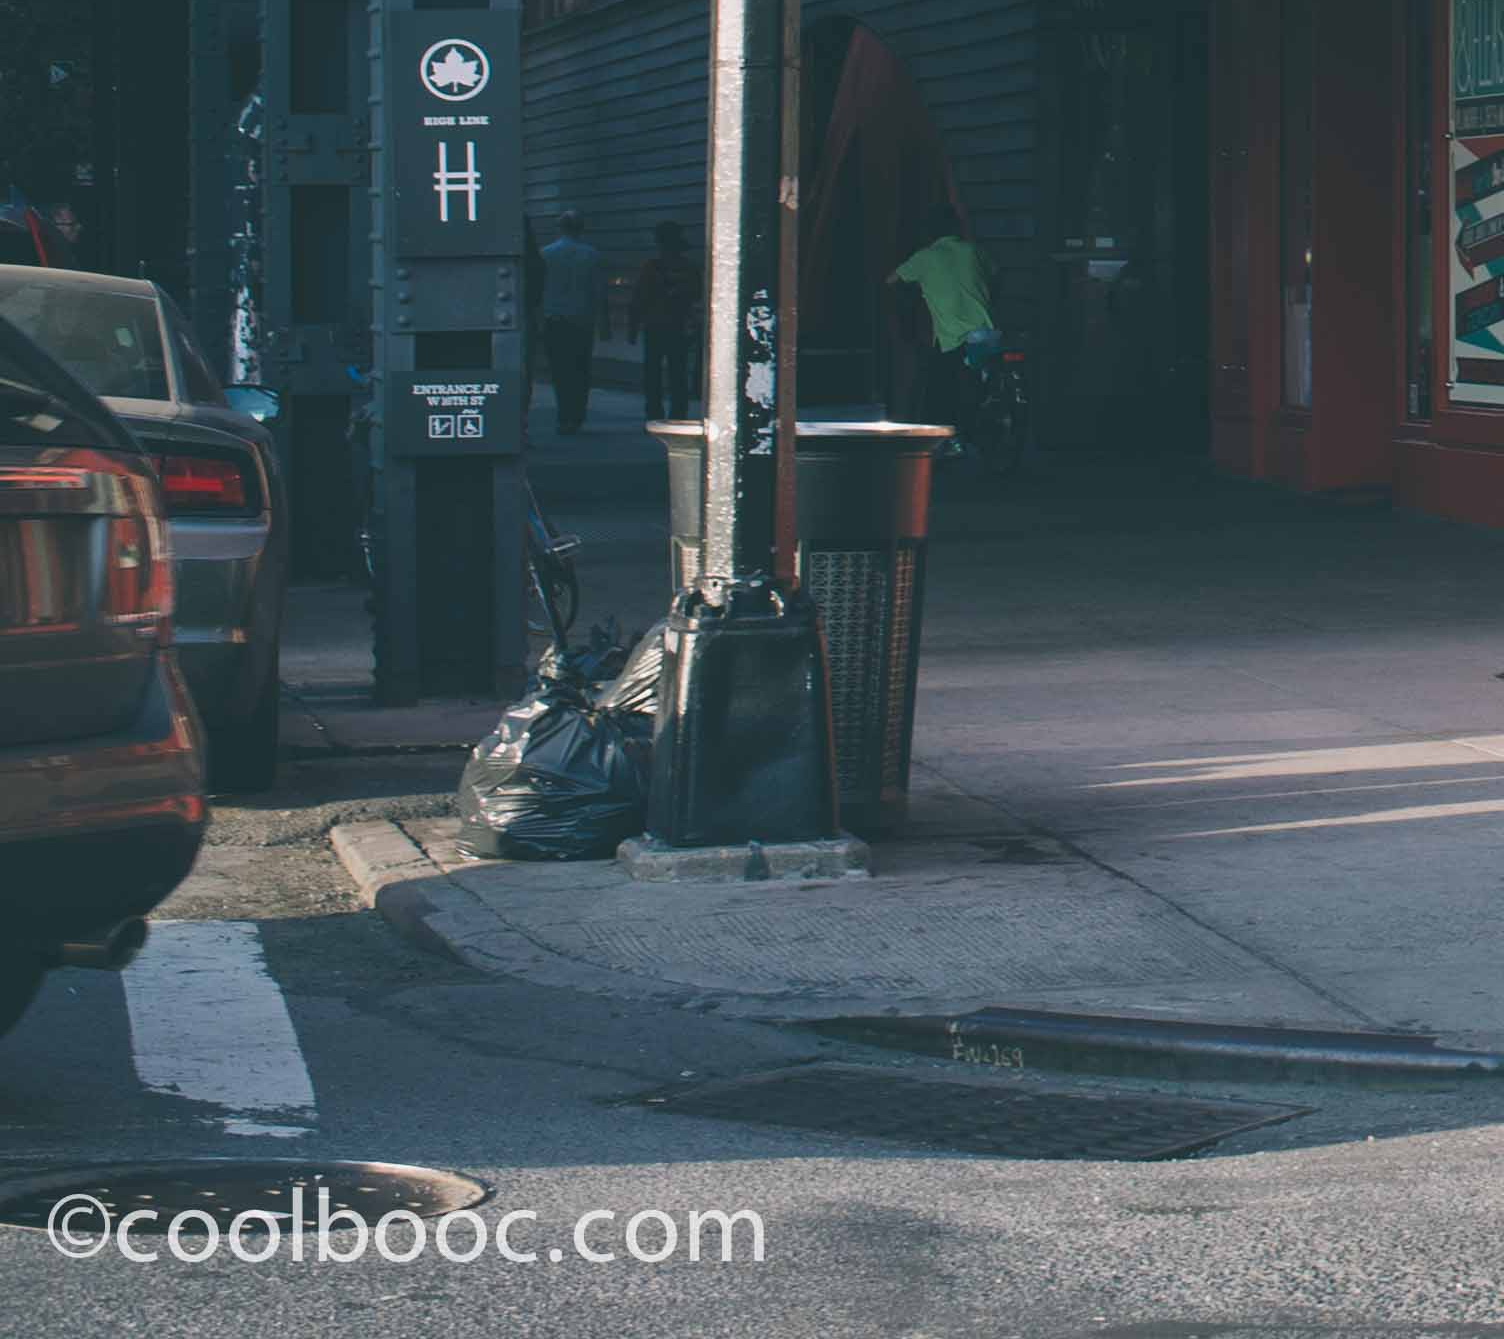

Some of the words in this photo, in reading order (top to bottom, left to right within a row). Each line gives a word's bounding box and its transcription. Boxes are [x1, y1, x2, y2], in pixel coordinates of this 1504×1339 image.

[423, 116, 456, 126] HIGH
[458, 115, 489, 125] LINE
[412, 384, 481, 395] ENTRANCE
[482, 383, 499, 394] AT
[426, 396, 441, 406] W
[469, 396, 486, 406] ST
